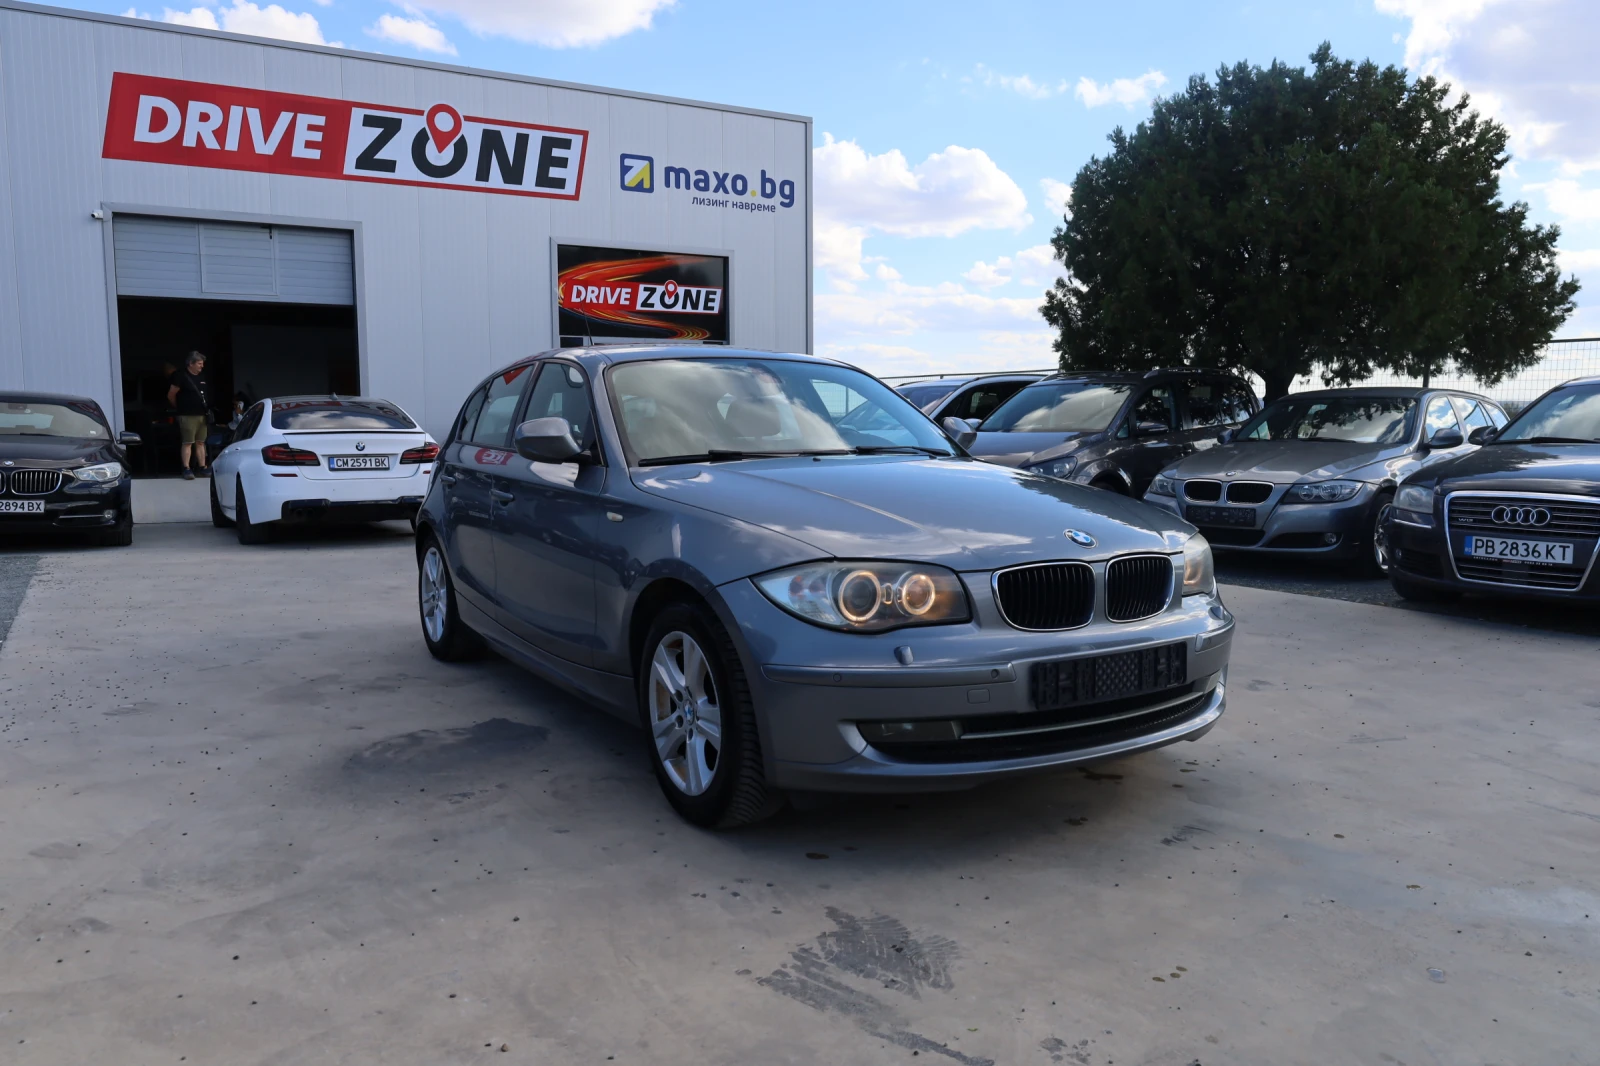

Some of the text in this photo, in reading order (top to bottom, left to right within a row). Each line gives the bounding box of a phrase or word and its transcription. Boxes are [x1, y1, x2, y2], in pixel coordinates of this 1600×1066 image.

[133, 94, 572, 190] DRIVE ZONE
[664, 166, 795, 208] maxo.bg
[692, 196, 776, 213] лизинг навреме
[571, 285, 718, 311] DRIVE ZONE
[335, 458, 349, 467] CM
[350, 458, 373, 467] 2591
[374, 457, 387, 467] BK
[0, 501, 42, 511] 2894 BX
[1474, 538, 1571, 561] PB 2836 KT
